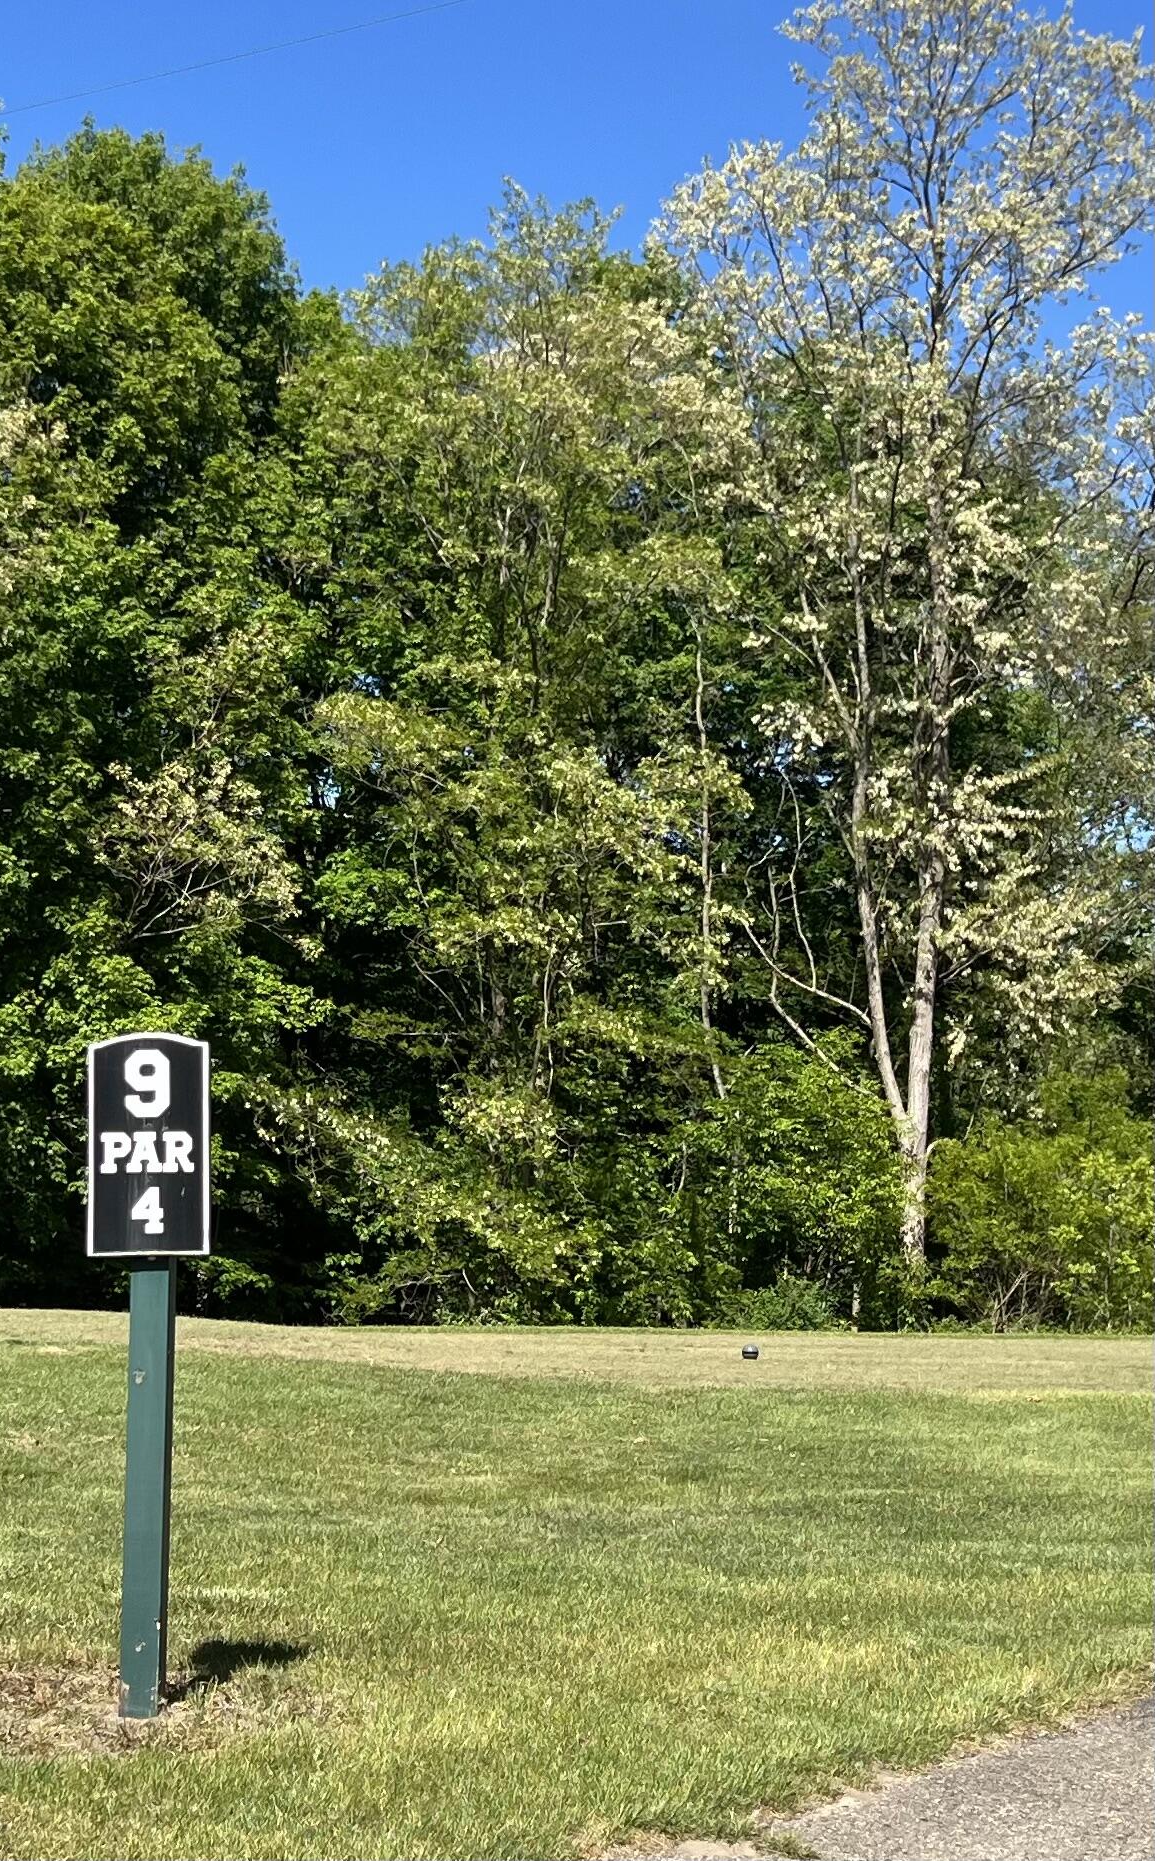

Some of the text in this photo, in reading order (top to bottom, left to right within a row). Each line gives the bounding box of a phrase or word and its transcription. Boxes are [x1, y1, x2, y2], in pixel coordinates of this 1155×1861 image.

[124, 1049, 170, 1118] 9
[100, 1131, 194, 1174] PAR
[131, 1186, 164, 1234] 4
